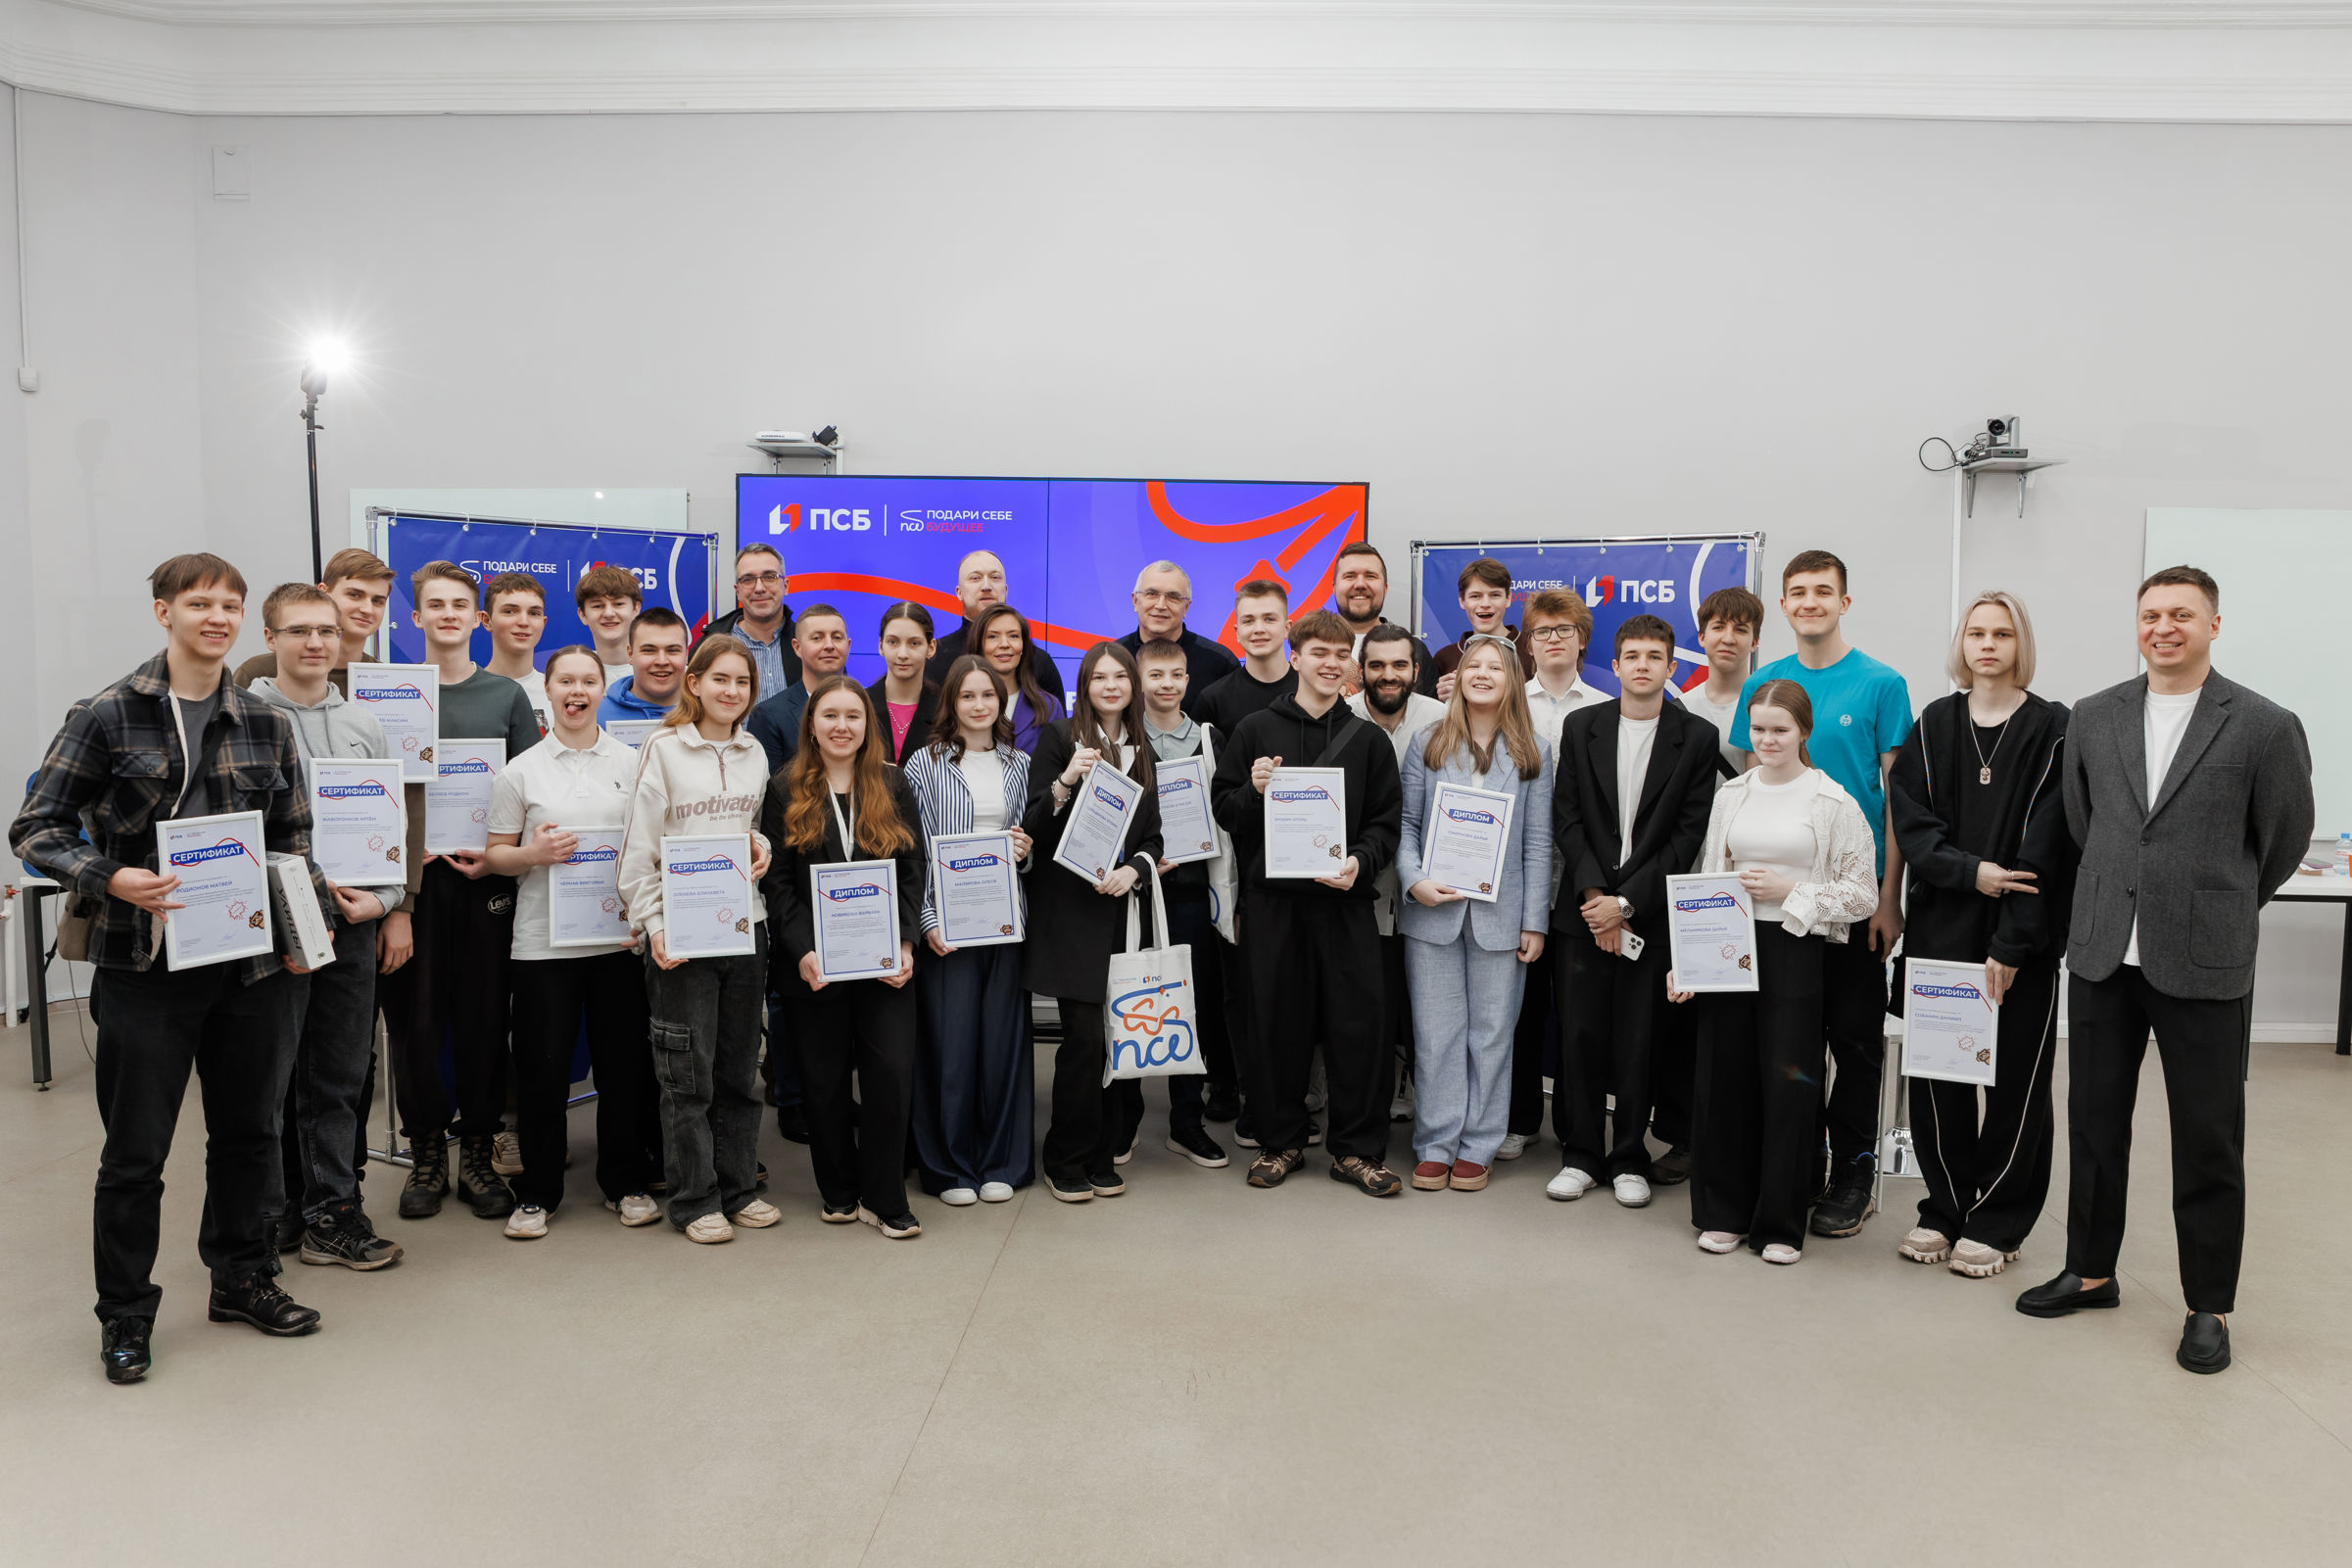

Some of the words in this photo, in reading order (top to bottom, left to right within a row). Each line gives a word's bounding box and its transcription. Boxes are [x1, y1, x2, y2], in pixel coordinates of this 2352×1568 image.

[810, 508, 871, 531] ПСБ
[928, 510, 979, 521] ПОДАРИ
[983, 511, 1012, 520] СЕБЕ
[927, 523, 984, 533] БУДУЩЕЕ
[484, 561, 529, 573] ПОДАРИ
[532, 563, 556, 573] СЕБЕ
[1511, 581, 1536, 590] ДАРИ
[1538, 581, 1562, 590] СЕБЕ
[1621, 580, 1675, 603] ПСБ
[1097, 789, 1123, 809] ДИПЛОМ
[676, 794, 758, 819] motivatio
[1453, 811, 1490, 822] ДИПЛОМ
[173, 845, 241, 863] СЕРТИФИКАТ
[672, 862, 732, 872] СЕРТИФИКАТ
[955, 859, 993, 868] ДИПЛОМ
[211, 880, 232, 889] МАТВЕЙ
[835, 888, 875, 898] ДИПЛОМ
[1678, 899, 1732, 908] СЕРТИФИКАТ
[1915, 986, 1978, 997] СЕРТИФИКАТ
